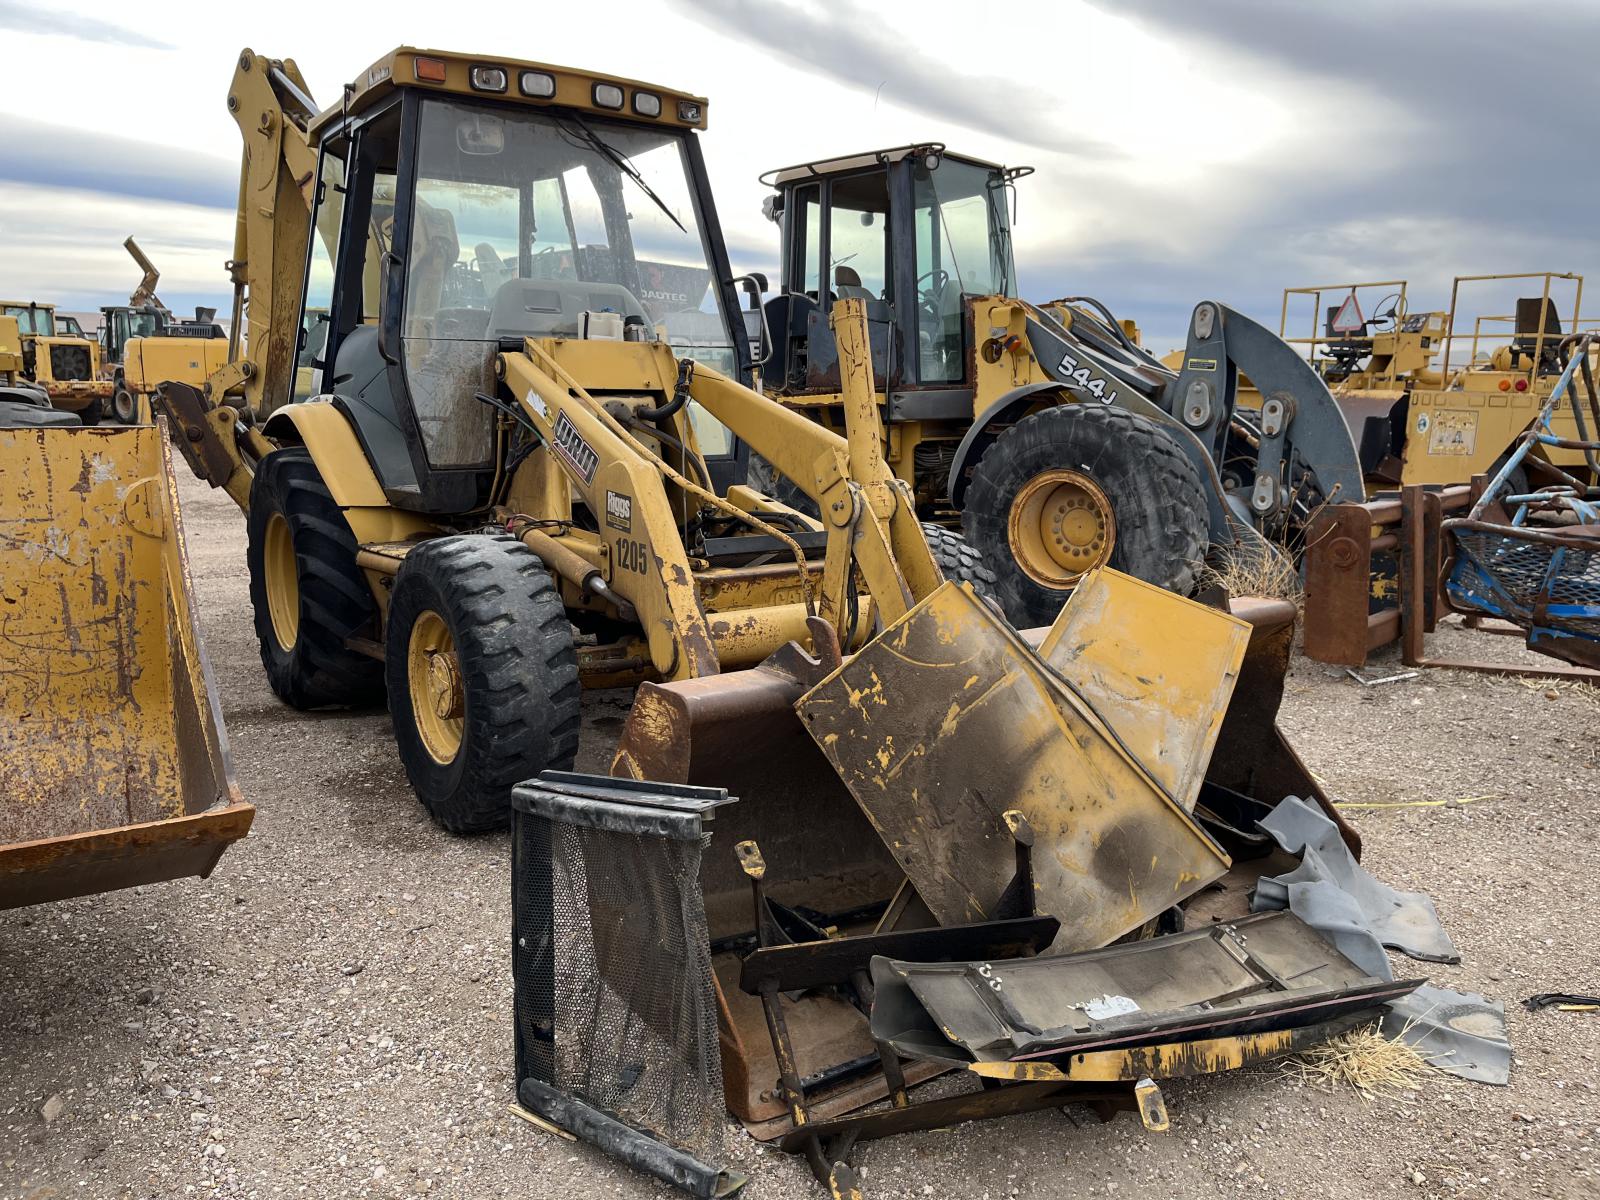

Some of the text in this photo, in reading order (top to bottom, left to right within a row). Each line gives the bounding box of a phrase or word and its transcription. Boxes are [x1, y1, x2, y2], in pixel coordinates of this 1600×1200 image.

[641, 288, 688, 302] OADTEC
[1057, 353, 1117, 405] 544J
[607, 491, 630, 518] Riggs
[616, 537, 648, 576] 1205
